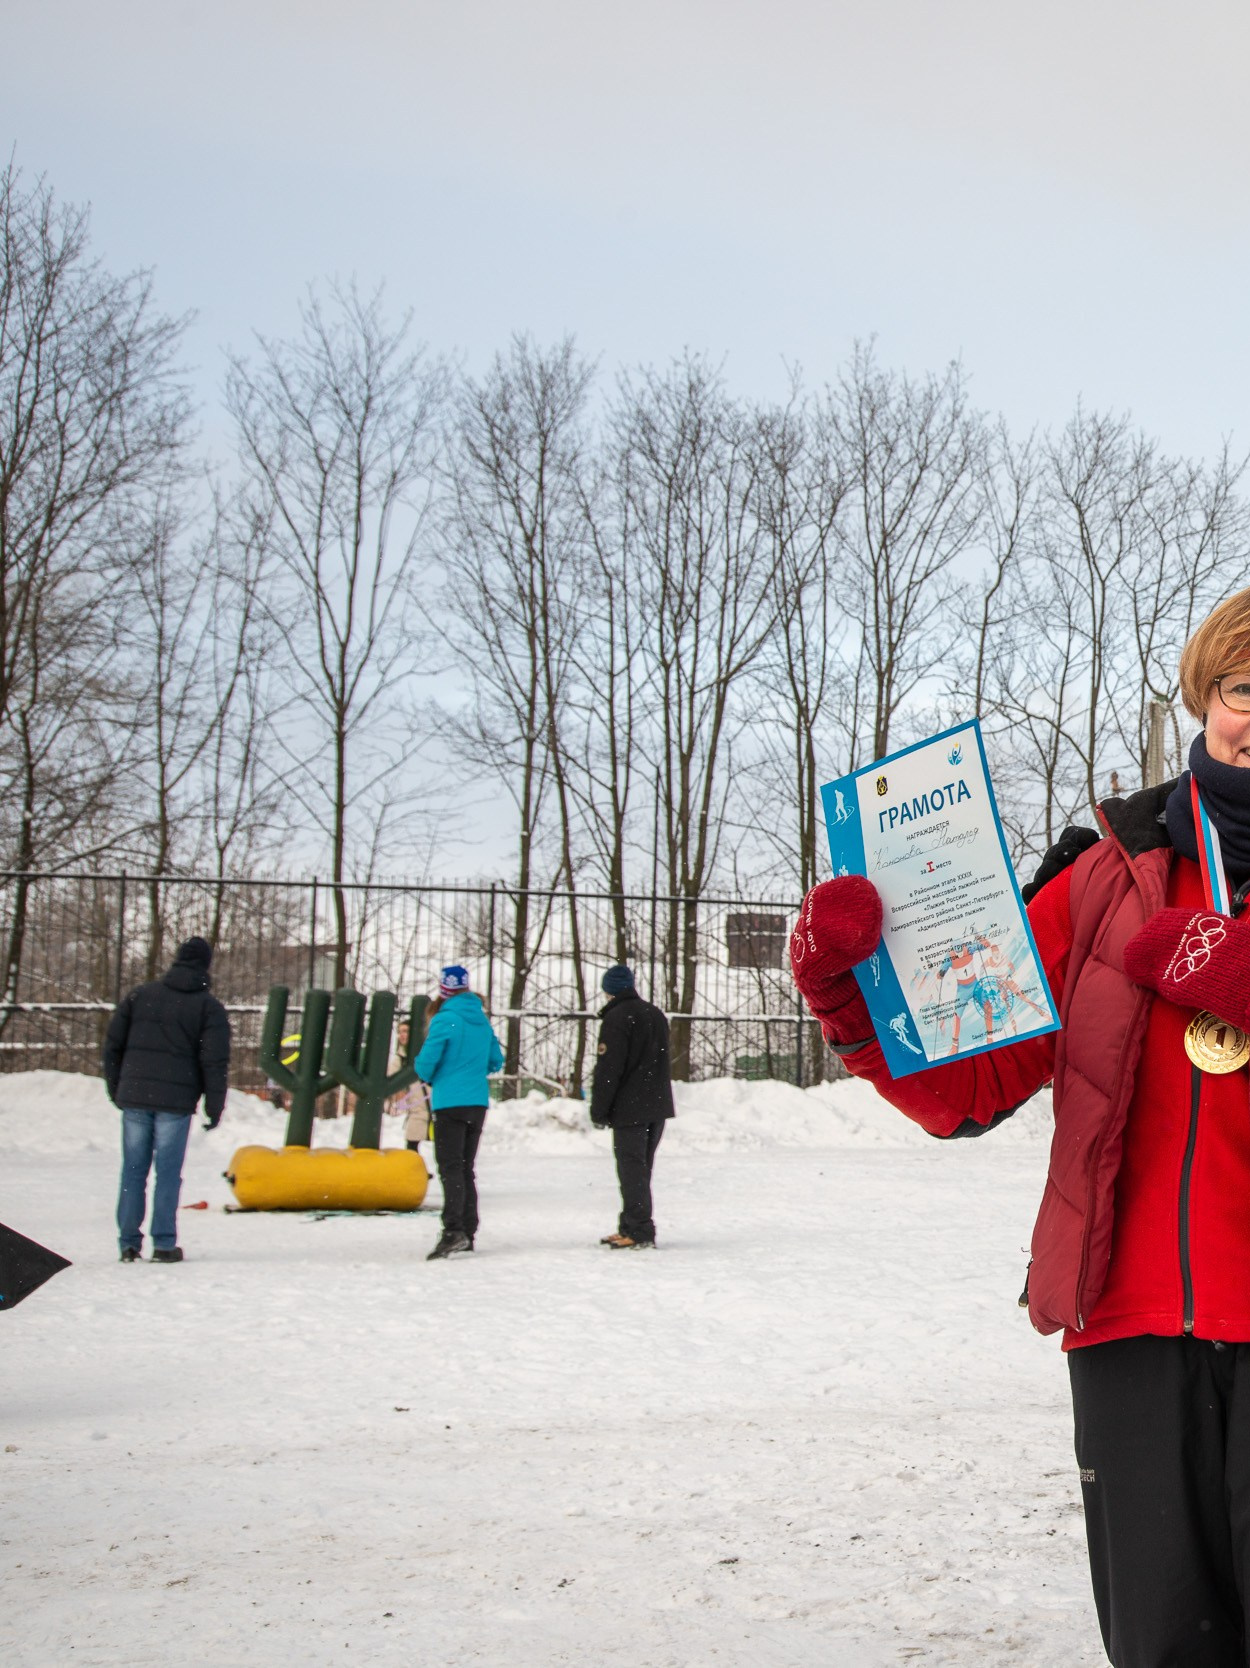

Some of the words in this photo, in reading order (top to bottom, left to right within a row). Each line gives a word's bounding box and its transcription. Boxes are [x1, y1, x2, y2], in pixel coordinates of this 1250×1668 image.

[878, 779, 972, 833] ГРАМОТА
[905, 820, 950, 841] НАГРАЖДАЕТСЯ
[920, 868, 927, 876] за
[935, 860, 952, 870] место
[891, 894, 931, 914] Всероссийской
[932, 885, 957, 900] массовой
[958, 878, 980, 891] лыжной
[980, 873, 996, 883] гонки
[913, 882, 941, 897] Районном
[941, 877, 957, 888] этапе
[946, 893, 968, 905] России»
[890, 913, 935, 933] Адмиралтейского
[936, 906, 955, 918] района
[955, 890, 1005, 910] Санкт-Петербурга
[807, 928, 817, 953] 2010
[925, 937, 954, 951] дистанции
[924, 946, 954, 961] возрастной
[1213, 1025, 1228, 1049] 1
